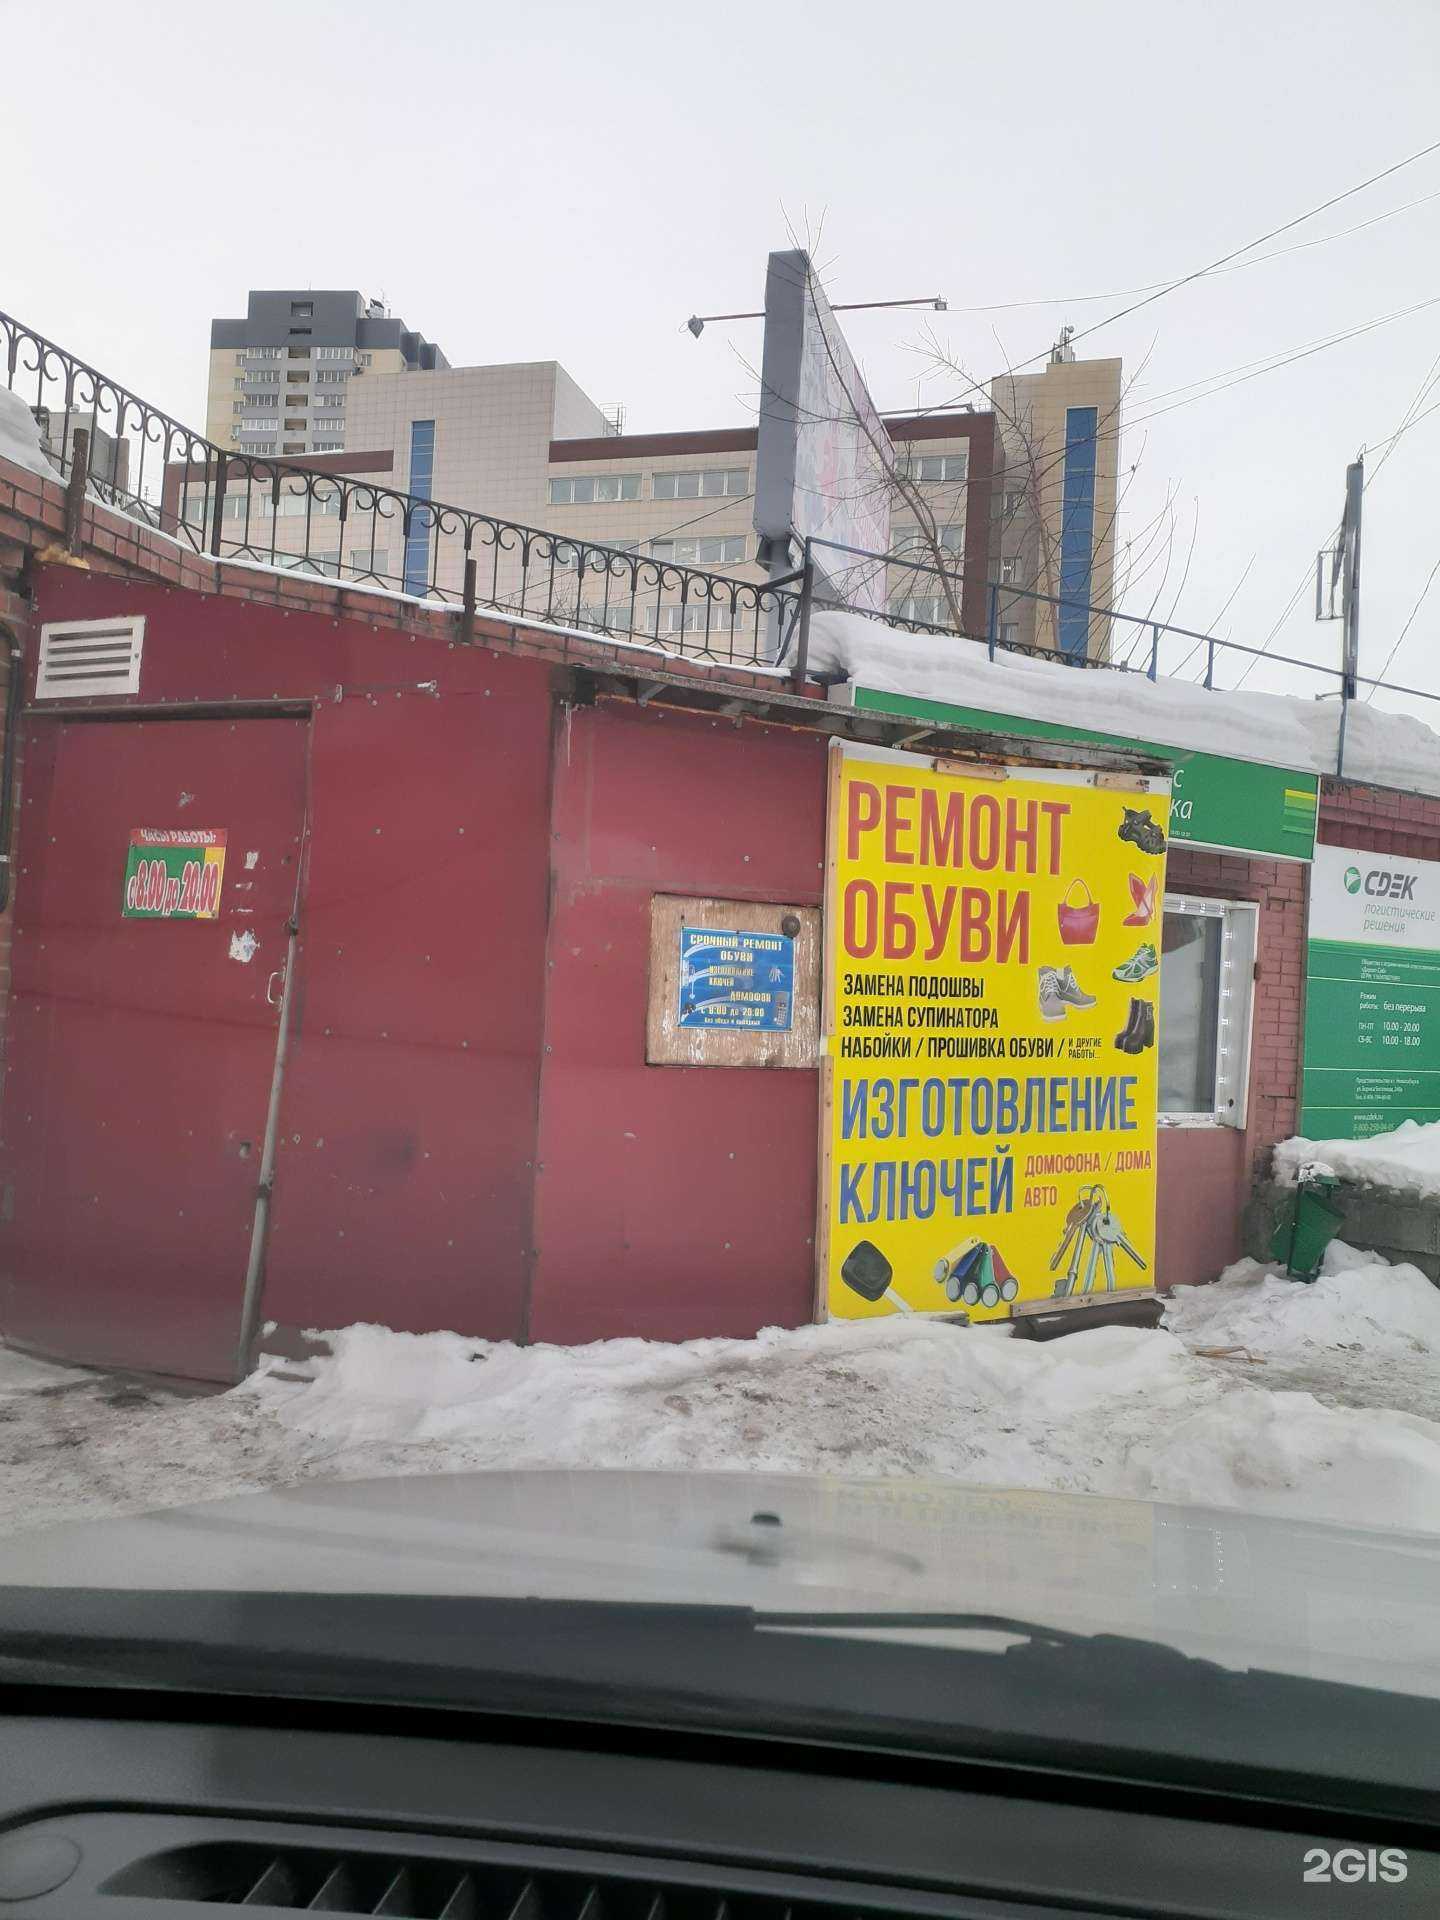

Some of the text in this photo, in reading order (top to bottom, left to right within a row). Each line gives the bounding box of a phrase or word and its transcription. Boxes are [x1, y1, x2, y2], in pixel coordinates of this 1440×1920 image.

[847, 780, 1071, 876] РЕМОНТ
[1364, 870, 1418, 900] CDEK
[843, 879, 1031, 965] ОБУВИ
[1363, 920, 1406, 933] решения
[690, 934, 784, 951] СРОЧНЫЙ РЕМОНТ
[720, 950, 753, 963] ОБУВИ
[730, 991, 771, 1003] ДОМОФОН
[843, 973, 984, 1000] ЗАМЕНА ПОДОШВЫ
[842, 1005, 999, 1028] ЗАМЕНА СУПИНАТОРА
[1383, 1001, 1395, 1011] без
[1395, 1003, 1426, 1014] перерыва
[1383, 1021, 1399, 1032] 10.00
[1403, 1022, 1420, 1033] 20.00
[841, 1033, 1064, 1058] НАБОЙКИ / ПРОШИВКА ОБУВИ /
[1068, 1037, 1102, 1048] И ДРУГИЕ
[1382, 1035, 1399, 1046] 10.00
[1404, 1036, 1420, 1047] 18.00
[842, 1076, 1138, 1140] ИЗГОТОВЛЕНИЕ
[1024, 1150, 1152, 1178] ДОМОФОНА / ДОМА
[839, 1144, 1014, 1224] КЛЮЧЕЙ
[1024, 1186, 1057, 1208] АВТО
